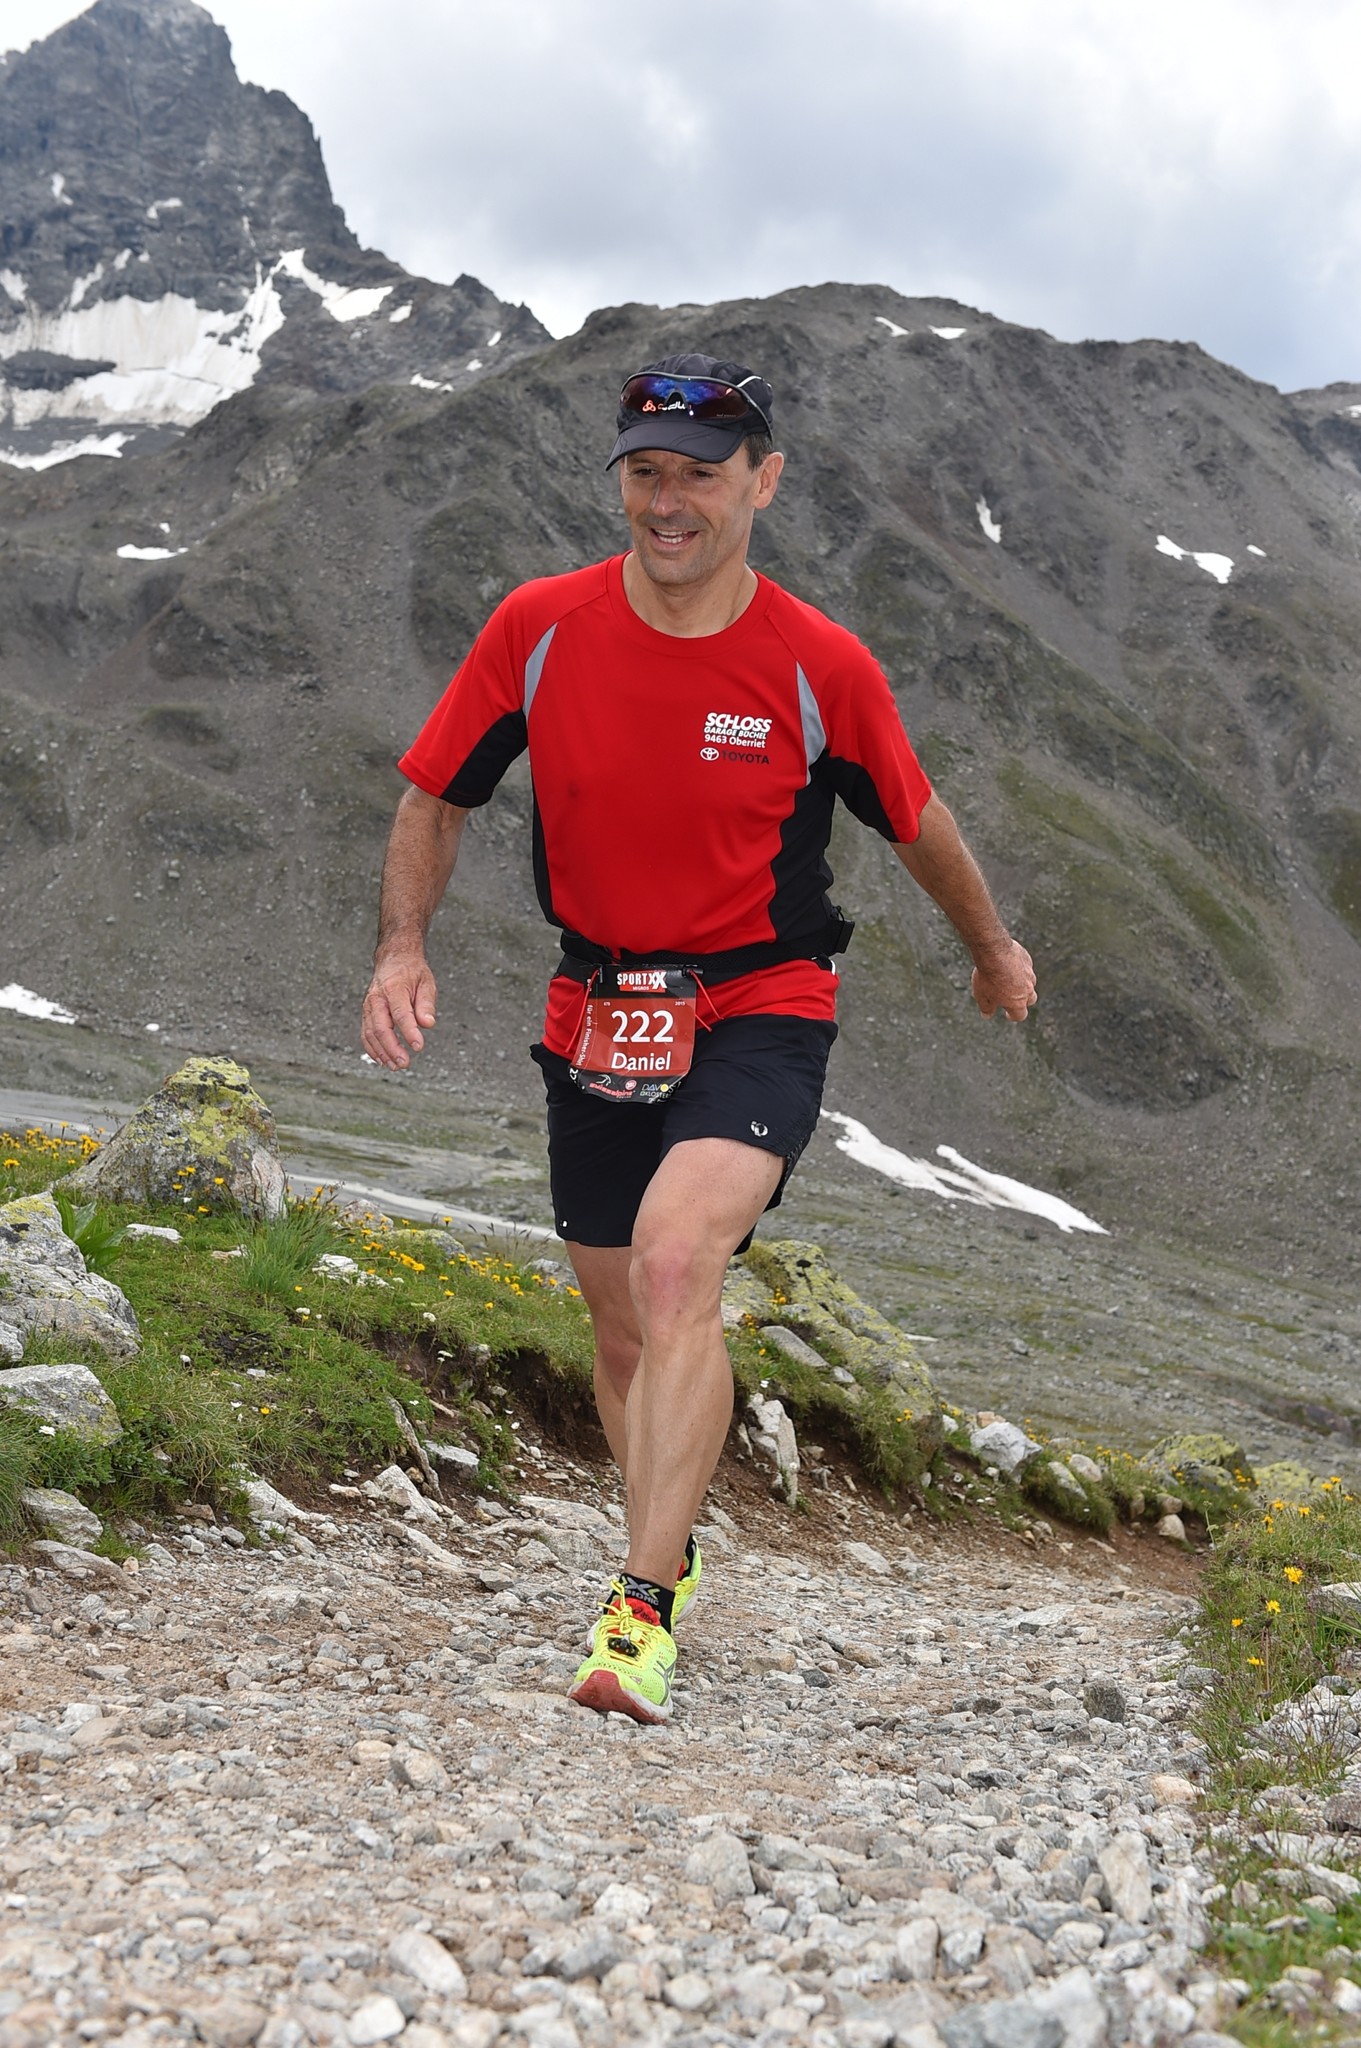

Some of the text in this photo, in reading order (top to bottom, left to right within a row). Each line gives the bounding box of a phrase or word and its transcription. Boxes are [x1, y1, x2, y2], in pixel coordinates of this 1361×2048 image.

[704, 727, 737, 736] GARAGE
[705, 712, 773, 733] SCHLOSS
[704, 733, 766, 749] 9463 Oberriet
[722, 750, 770, 764] TOYOTA
[611, 1010, 674, 1043] 222
[611, 1051, 672, 1071] Daniel
